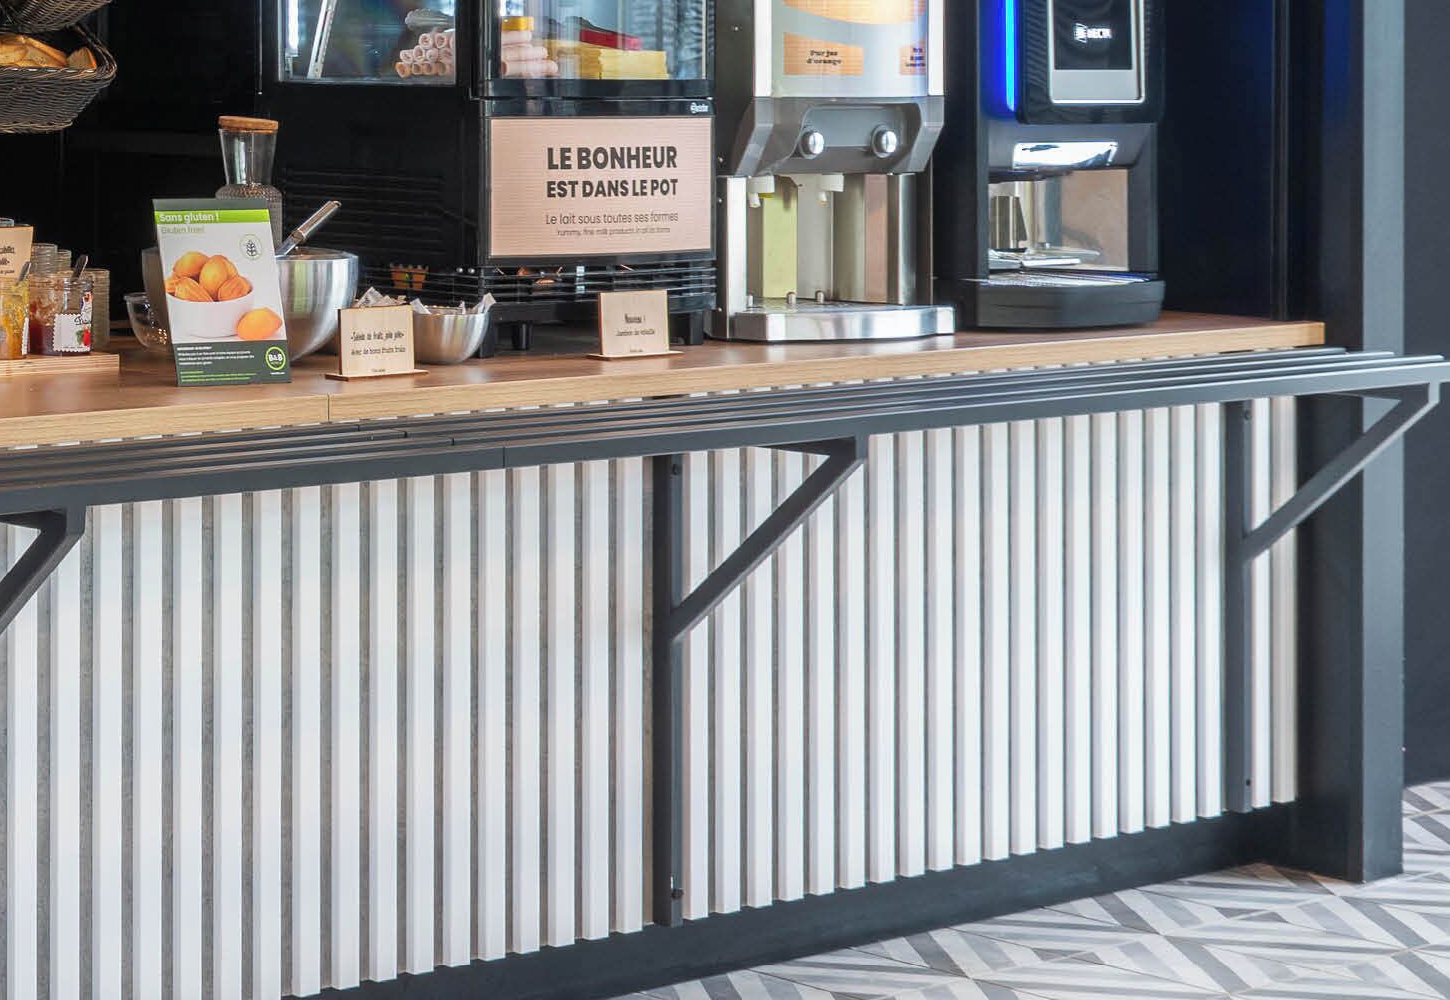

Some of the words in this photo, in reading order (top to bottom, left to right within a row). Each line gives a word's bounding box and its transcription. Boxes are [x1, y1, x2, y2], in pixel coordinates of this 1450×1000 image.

[547, 147, 572, 170] LE
[577, 146, 678, 170] BONHEUR
[546, 180, 579, 198] EST
[582, 179, 629, 198] DANS
[632, 179, 648, 197] LE
[650, 178, 678, 196] POT
[160, 213, 183, 222] Sans
[184, 211, 215, 224] gluten
[546, 214, 557, 225] Le
[559, 213, 576, 224] lait
[578, 215, 601, 224] sous
[603, 212, 632, 223] toutes
[635, 214, 648, 222] ses
[650, 211, 678, 222] formes
[269, 353, 283, 362] B&B
